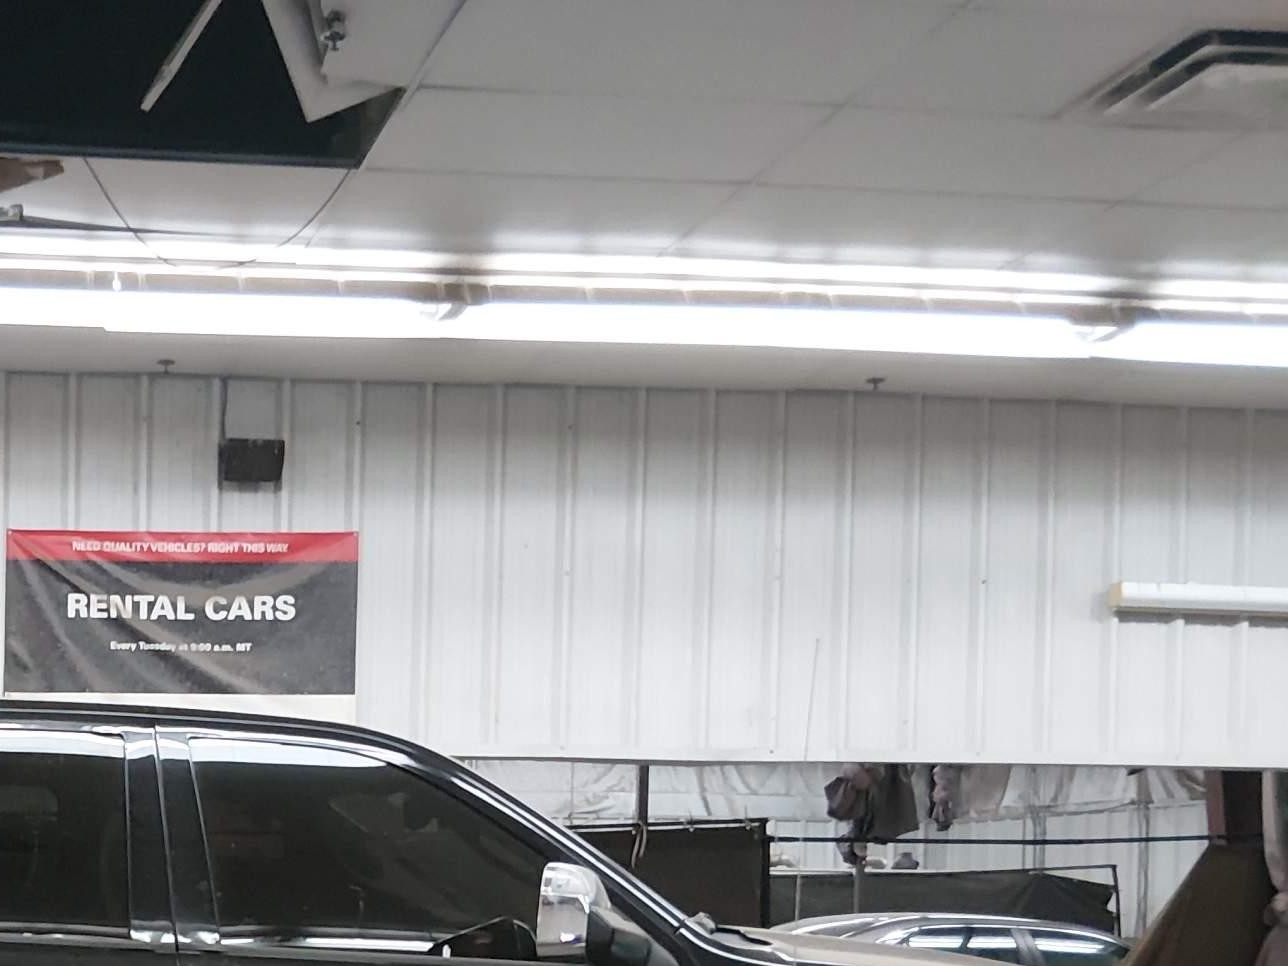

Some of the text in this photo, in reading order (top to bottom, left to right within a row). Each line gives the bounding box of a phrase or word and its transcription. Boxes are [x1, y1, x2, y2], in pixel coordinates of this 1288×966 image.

[72, 540, 289, 553] NEED QUALITY VEHICLES? RIGHT THIS WAY
[67, 593, 296, 621] RENTAL CARS
[110, 640, 137, 652] Every
[139, 641, 176, 652] Tuesday
